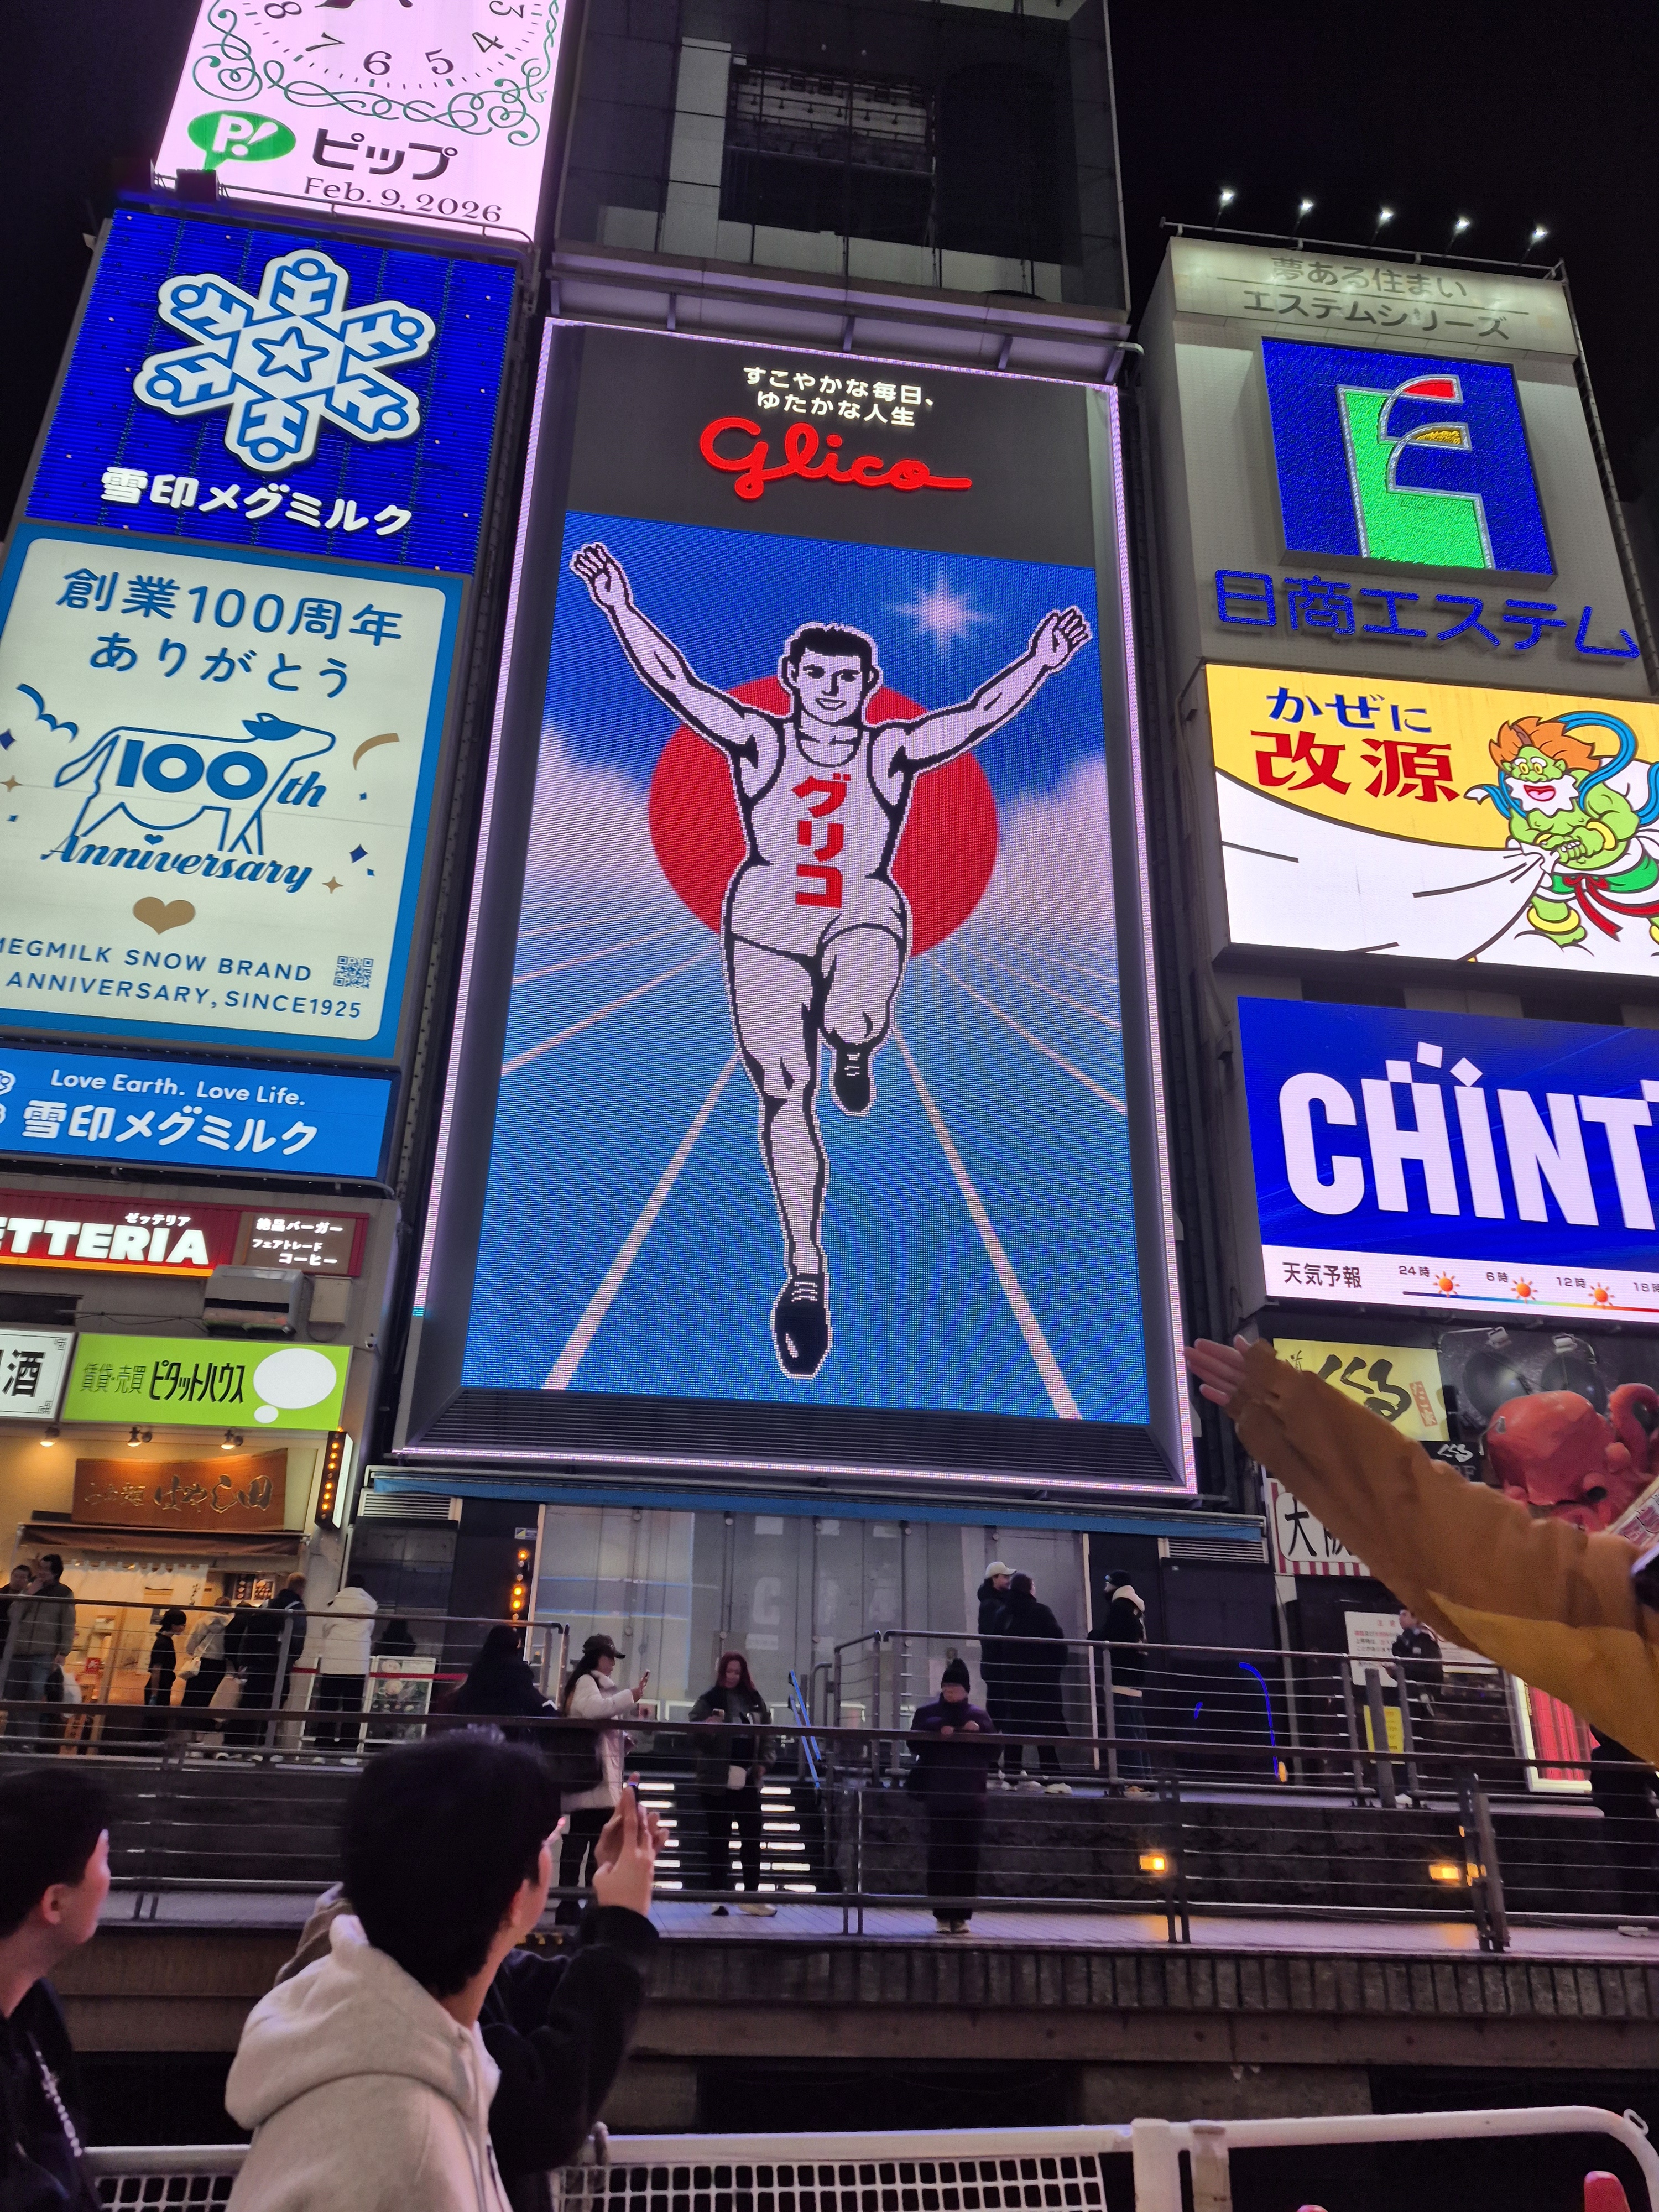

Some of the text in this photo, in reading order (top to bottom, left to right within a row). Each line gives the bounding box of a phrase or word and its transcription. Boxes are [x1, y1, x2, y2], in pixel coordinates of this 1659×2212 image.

[305, 32, 345, 51] 7
[363, 50, 392, 75] 6
[425, 48, 454, 75] 5
[312, 128, 458, 180] ピップ
[303, 177, 502, 222] Feb. 9, 2026
[1271, 255, 1467, 300] 夢ある住まい
[1244, 289, 1509, 340] エステムシリーズ
[743, 366, 935, 407] すこやかな毎日、
[757, 390, 916, 427] ゆたかな人生
[101, 466, 413, 536] 雪印メグミルク
[55, 567, 404, 647] 創業100周年
[1215, 569, 1641, 659] 日商エステム
[90, 632, 348, 698] ありがとう
[1265, 686, 1433, 733] かぜに
[1250, 729, 1460, 803] 改源
[792, 772, 851, 909] グリコ
[40, 834, 314, 894] Anniversary
[0, 937, 312, 982] EGMILK SNOW BRAND
[51, 1069, 306, 1107] Love Earth. Love Life.
[22, 1099, 318, 1156] 雪印メグミルク
[0, 1217, 210, 1265] TTERIA
[124, 1211, 192, 1228] ゼッテリア
[255, 1217, 344, 1234] 絶品バーガー
[252, 1238, 324, 1252] フェアトレード
[278, 1253, 338, 1266] コーヒー
[1282, 1261, 1363, 1290] 天気予報
[0, 1349, 46, 1397] 酒
[148, 1359, 246, 1404] ピタットハウス
